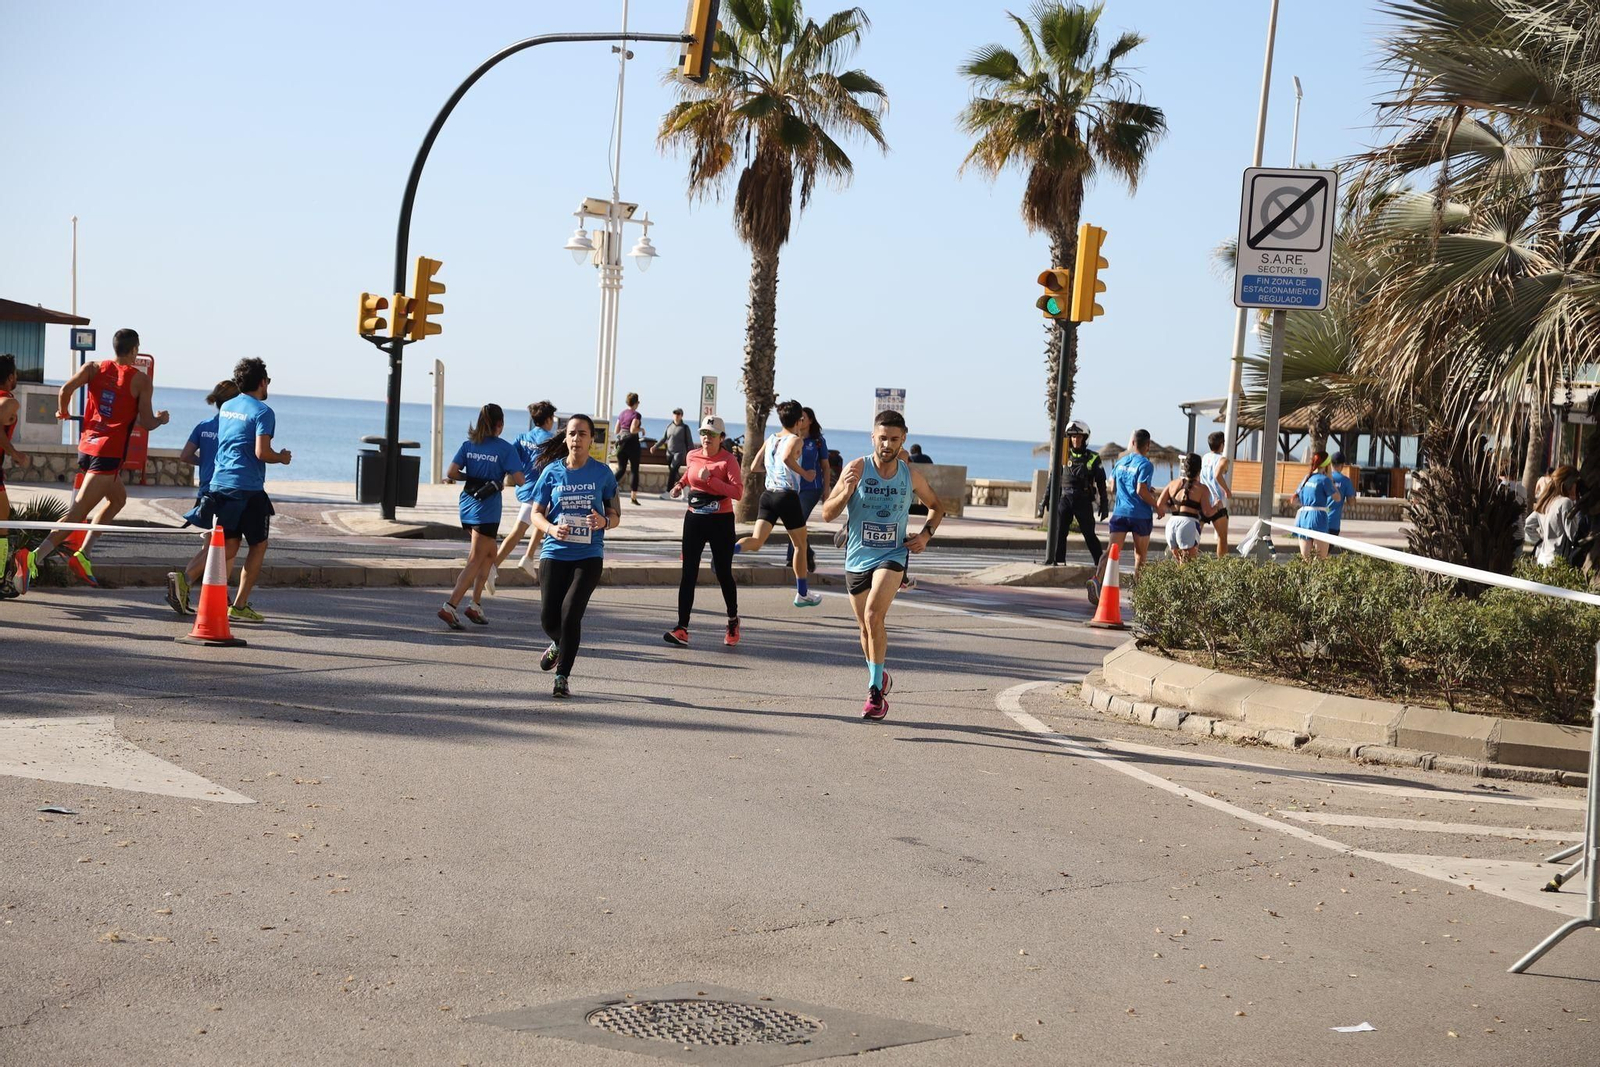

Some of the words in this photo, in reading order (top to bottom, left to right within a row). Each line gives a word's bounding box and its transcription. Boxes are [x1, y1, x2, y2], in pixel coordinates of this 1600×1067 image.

[1256, 277, 1270, 285] FIN
[1271, 278, 1294, 286] ZONA
[1243, 285, 1319, 296] ESTACIONAMIENTO
[1258, 294, 1302, 304] REGULADO
[557, 482, 596, 493] mayoral
[864, 485, 898, 497] nerja
[569, 527, 587, 536] 141
[866, 531, 893, 541] 1647
